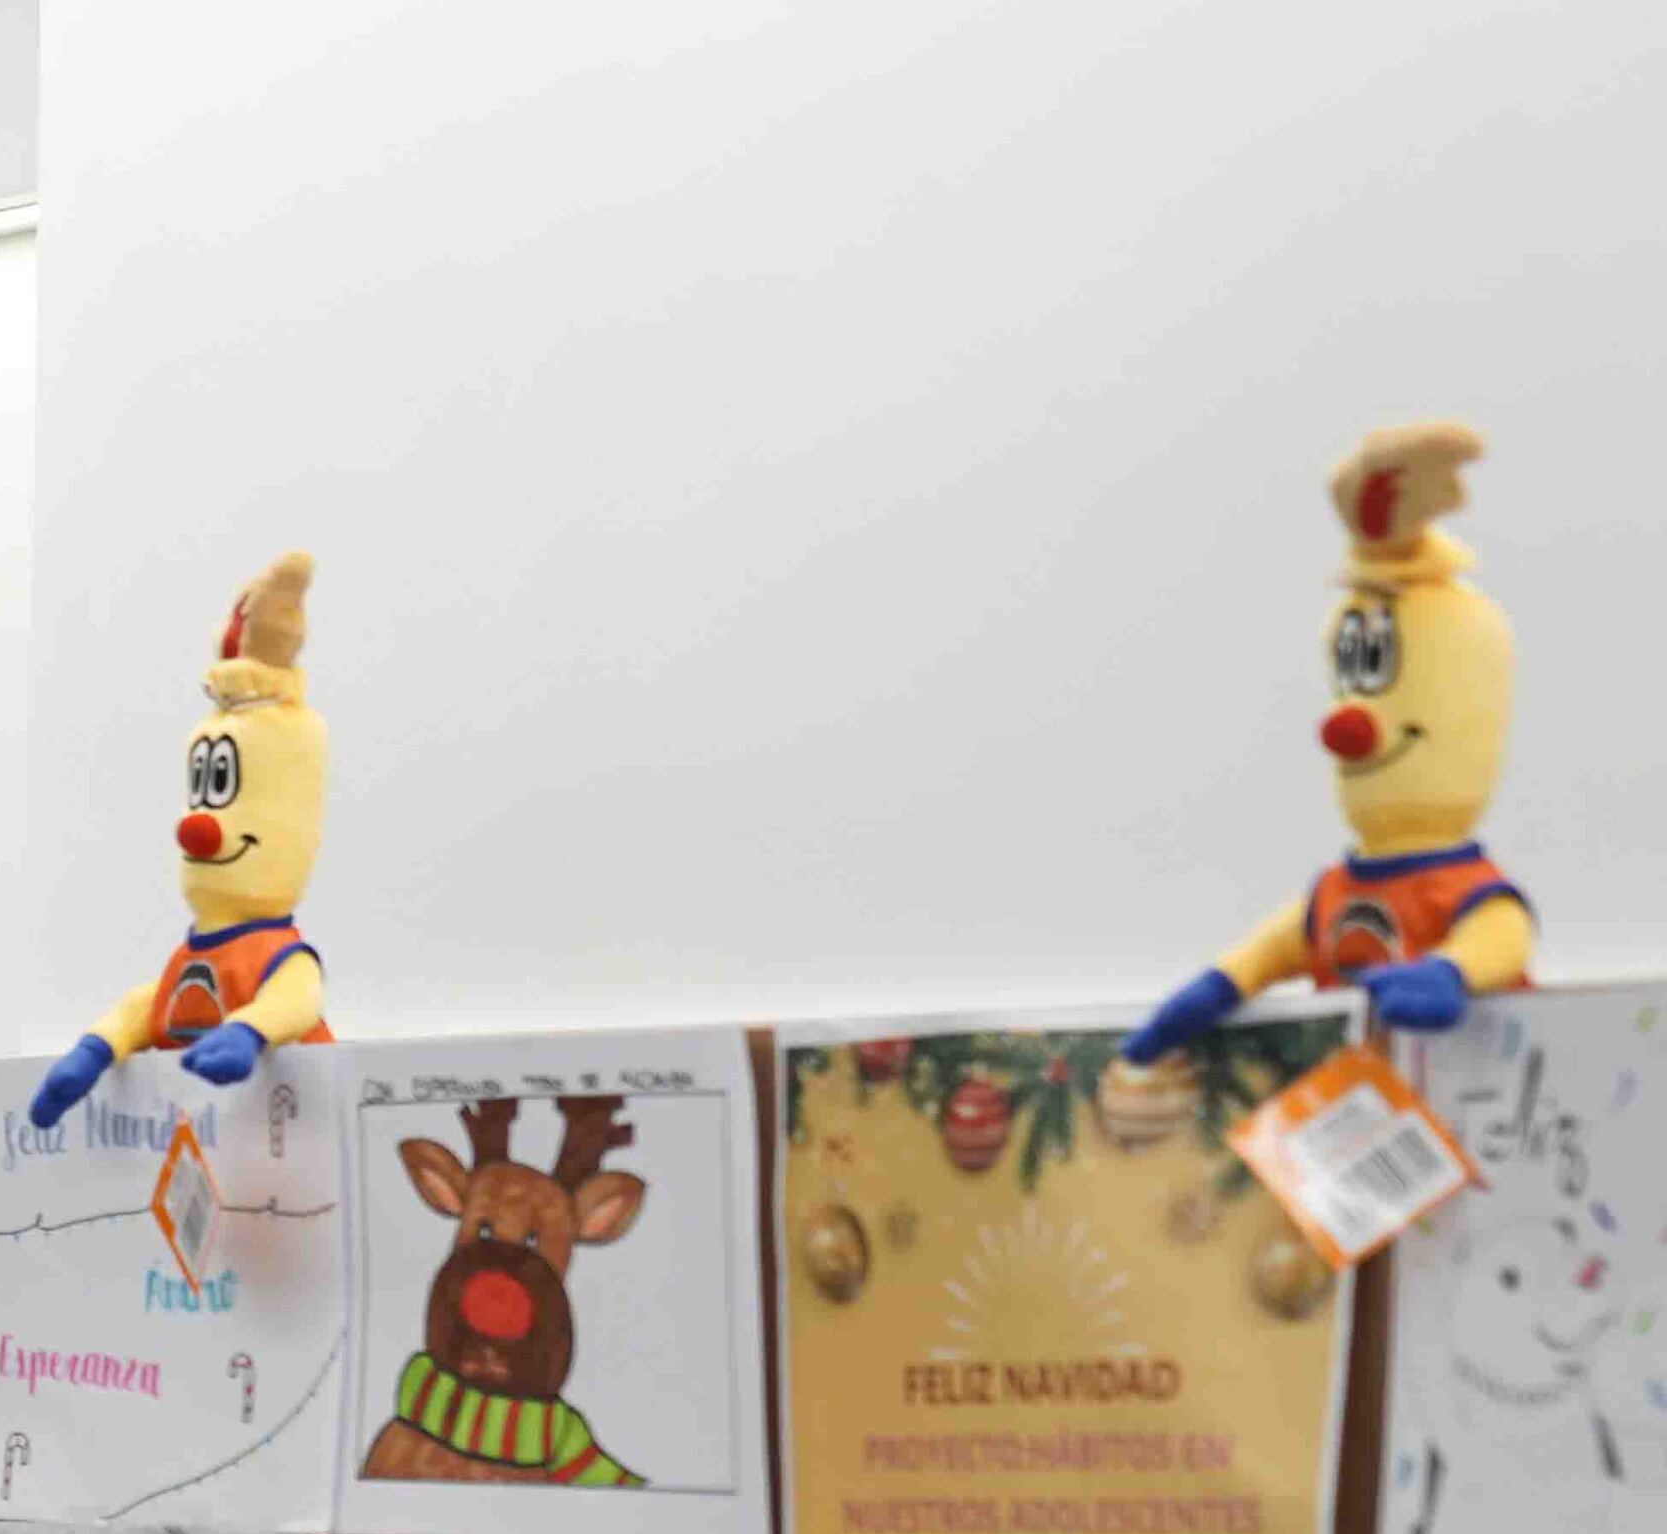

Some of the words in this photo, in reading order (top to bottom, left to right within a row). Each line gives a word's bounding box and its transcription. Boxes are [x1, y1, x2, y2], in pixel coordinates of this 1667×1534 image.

[0, 1333, 161, 1400] Esperanza
[902, 1362, 995, 1406] FELIZ
[1002, 1357, 1182, 1405] NAVIDAD
